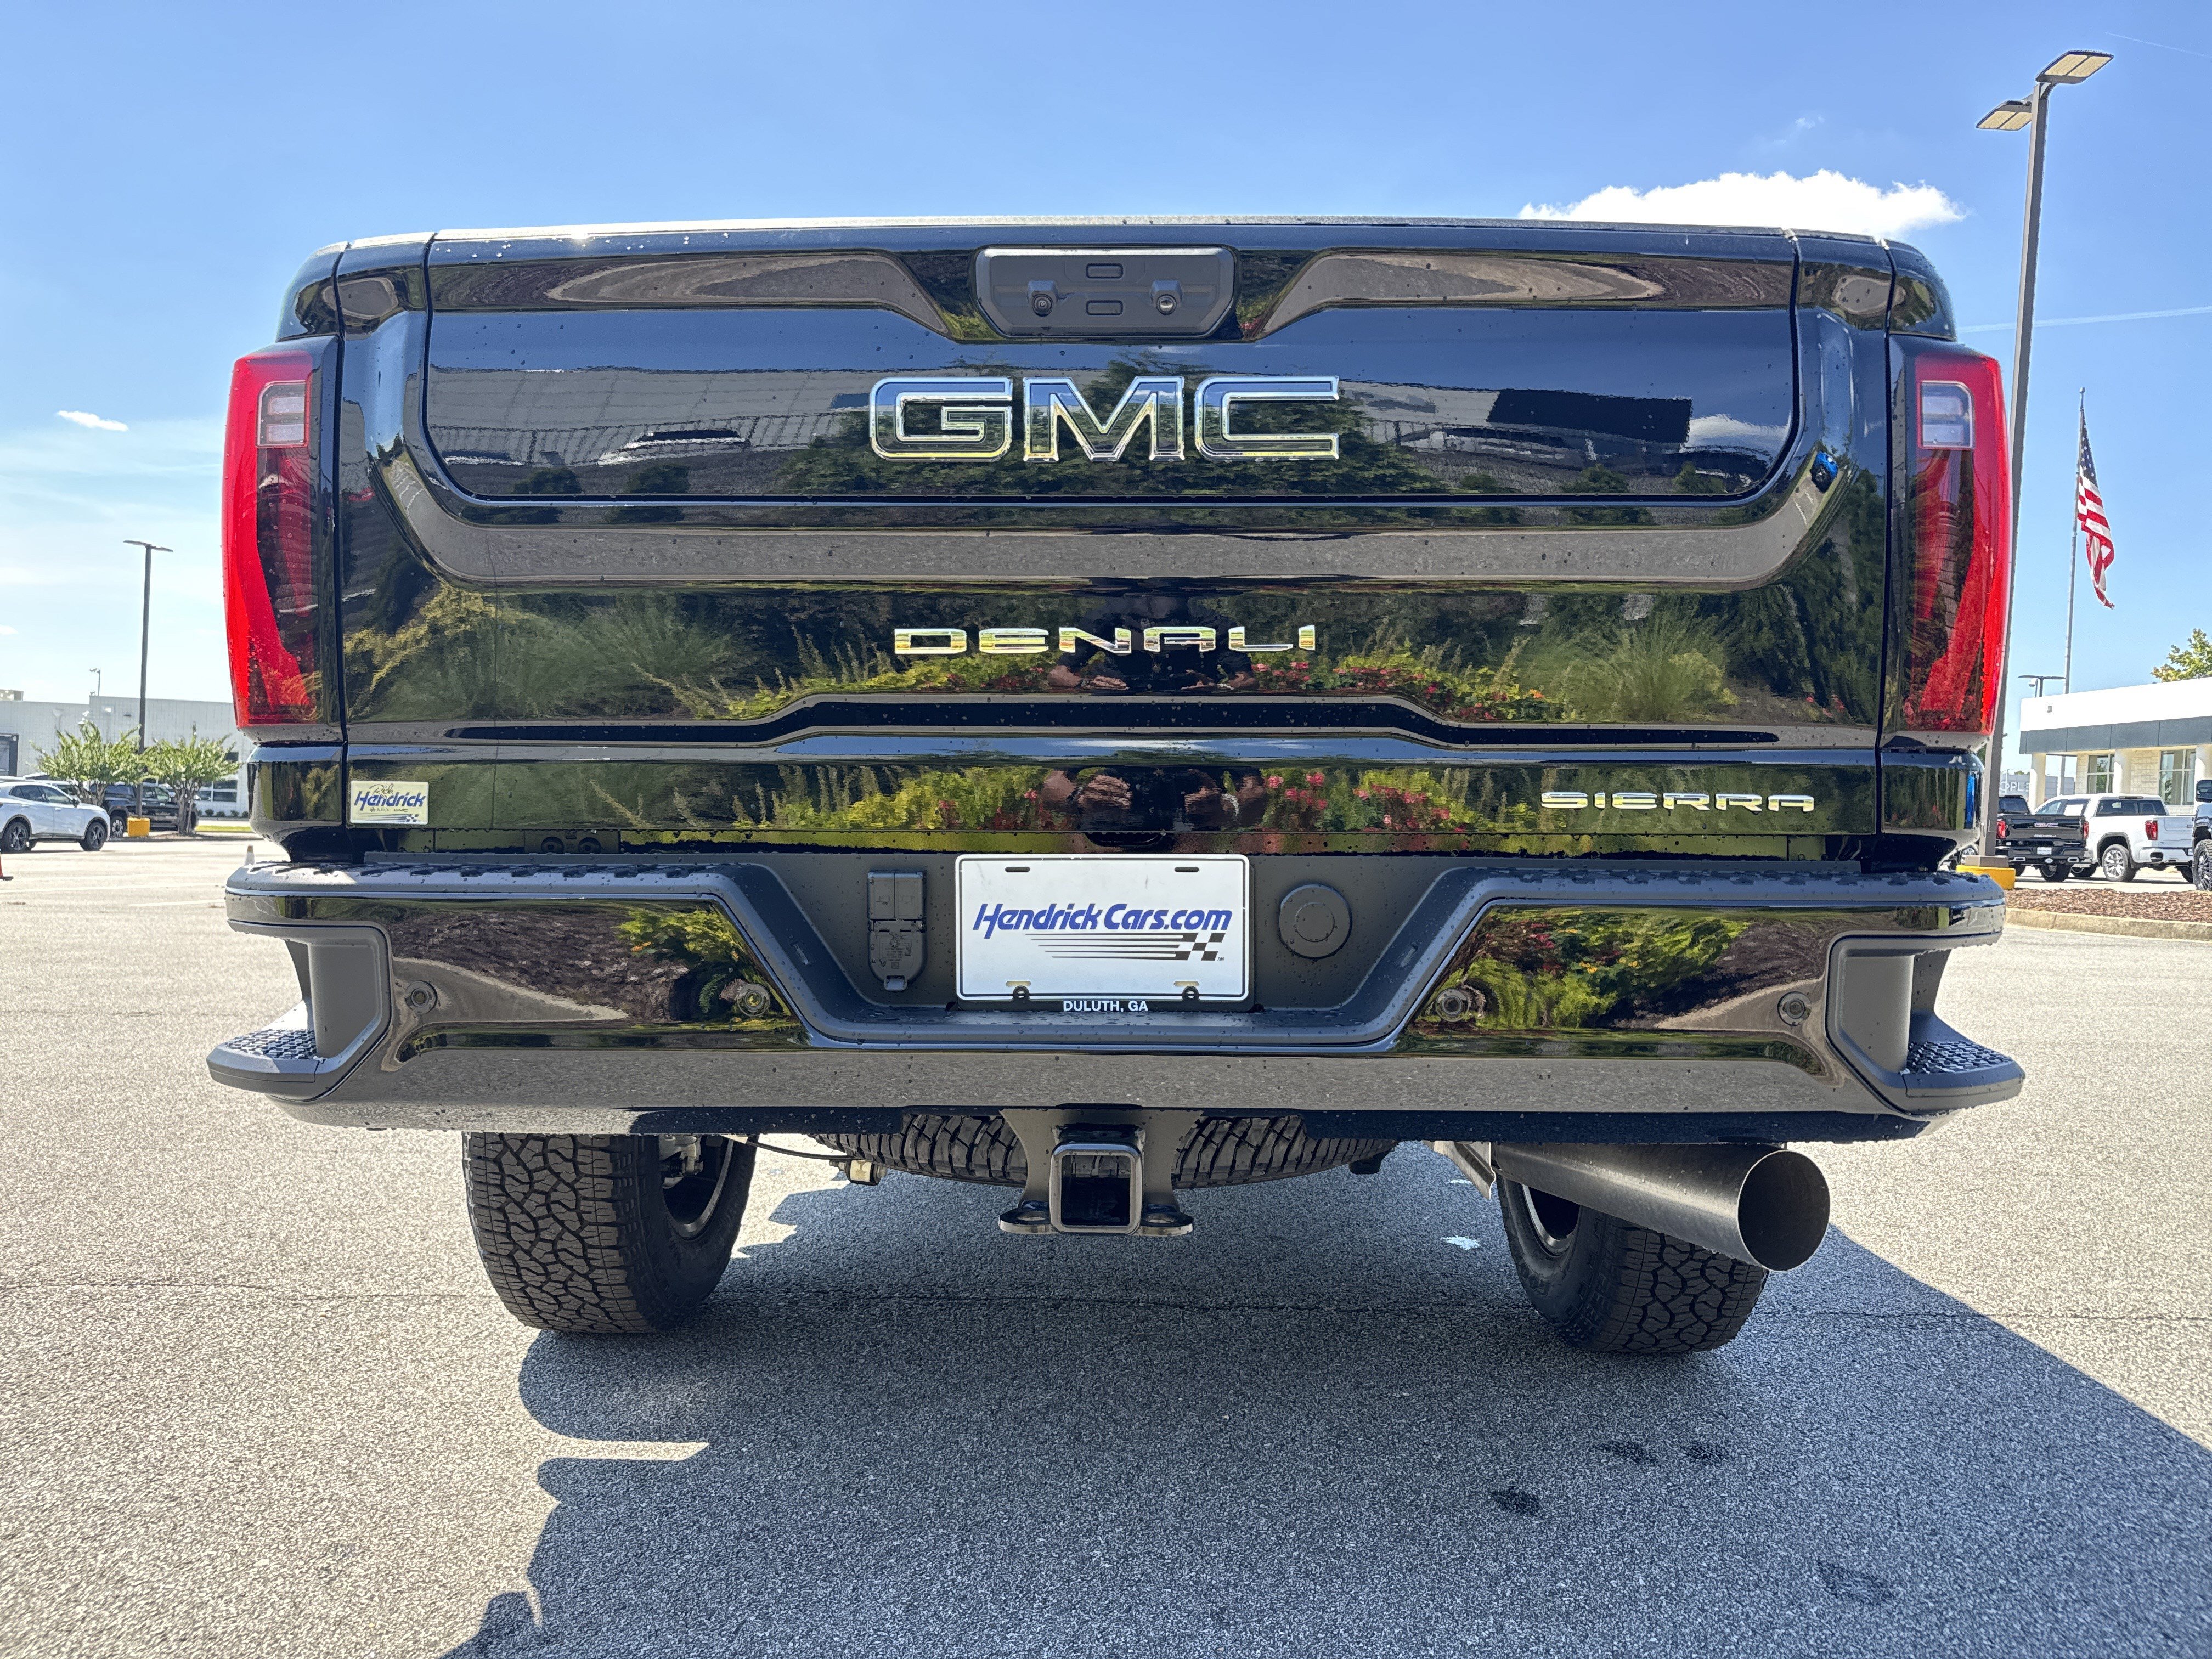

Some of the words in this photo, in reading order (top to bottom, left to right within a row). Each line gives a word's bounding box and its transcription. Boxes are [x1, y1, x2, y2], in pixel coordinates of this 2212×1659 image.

[869, 375, 1339, 462] GMC
[894, 625, 1316, 655] DENALI
[354, 791, 426, 811] Hendrick
[369, 783, 394, 799] Rick
[1541, 792, 1815, 812] SIERRA
[1063, 1000, 1124, 1012] DULUTH,
[1128, 1000, 1148, 1011] GA
